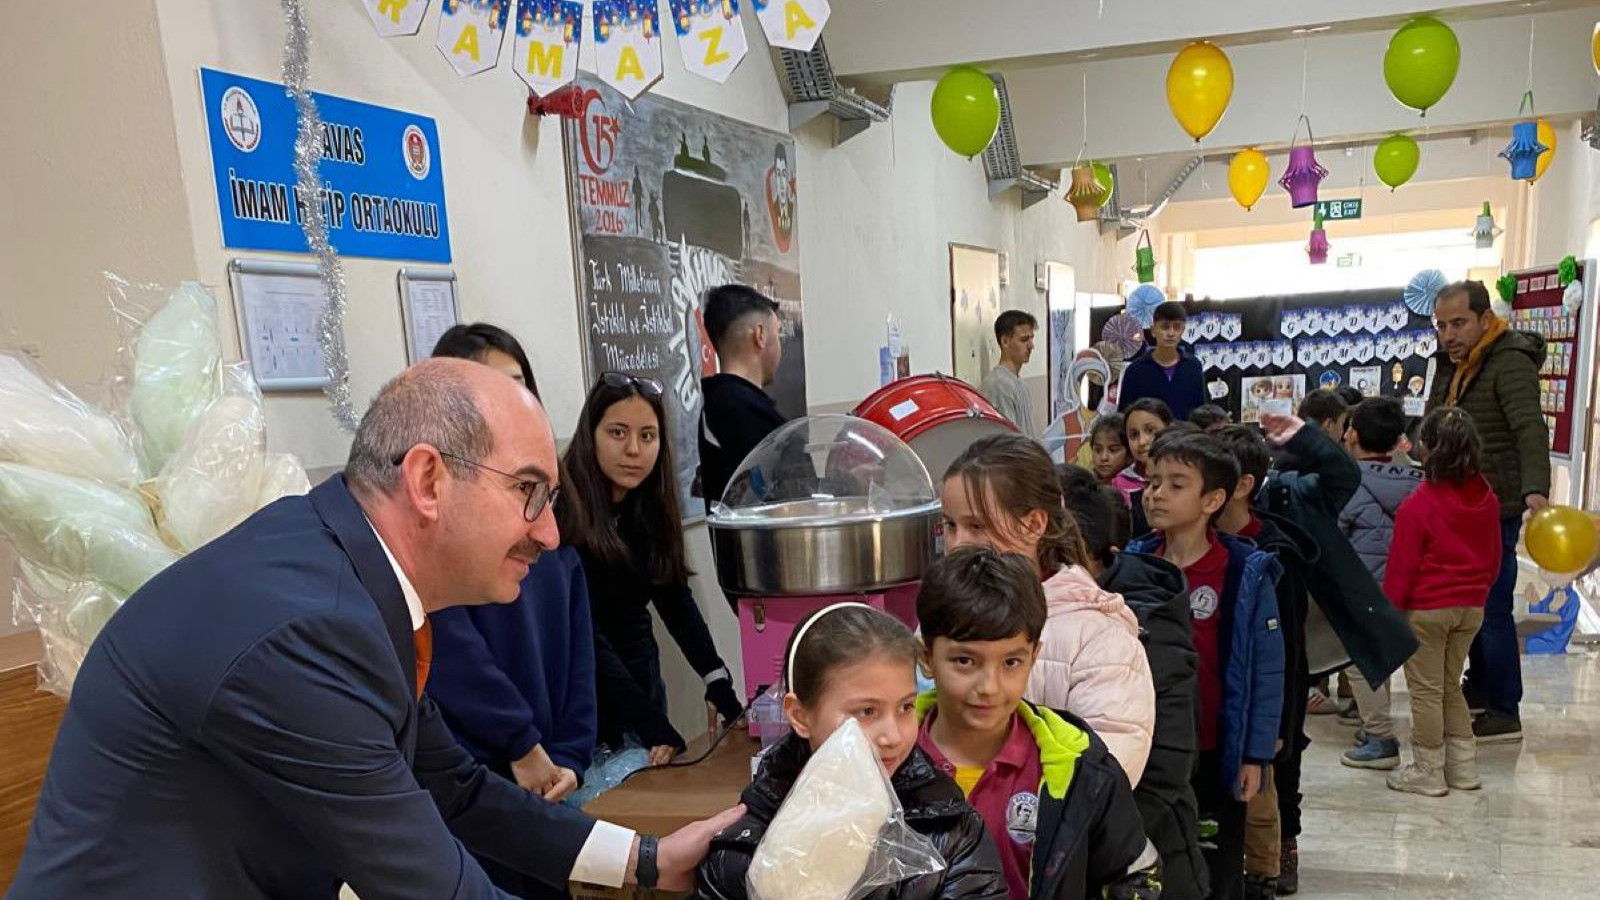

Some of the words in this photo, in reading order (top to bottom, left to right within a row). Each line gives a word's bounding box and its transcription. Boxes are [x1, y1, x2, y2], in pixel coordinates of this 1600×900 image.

[309, 121, 366, 166] AVAS
[229, 168, 290, 224] İMAM
[293, 181, 346, 230] HTİP
[351, 192, 440, 238] ORTAOKULU
[579, 175, 631, 208] TEMMUZ
[594, 209, 624, 233] 2016
[601, 342, 660, 371] Mücadelesi
